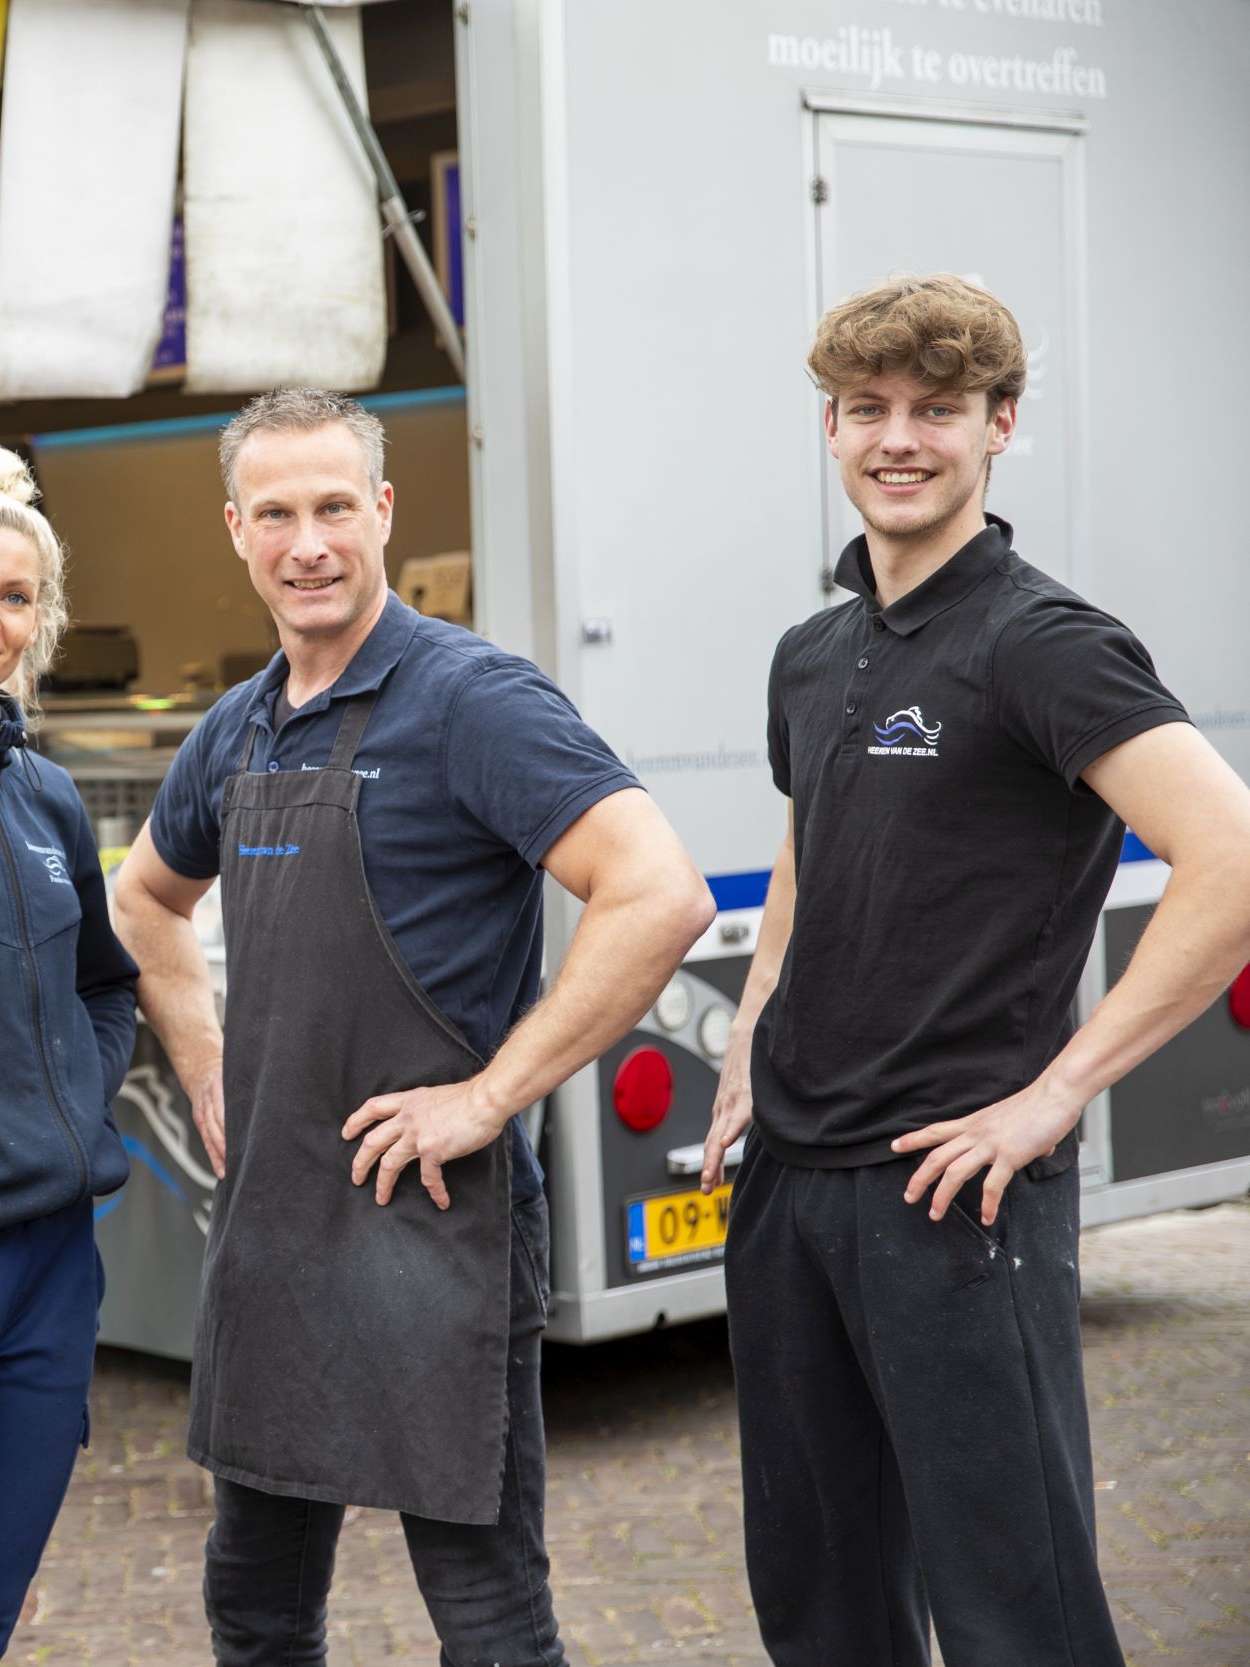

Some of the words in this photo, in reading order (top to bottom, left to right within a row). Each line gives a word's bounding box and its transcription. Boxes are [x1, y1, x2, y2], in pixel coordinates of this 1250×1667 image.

[767, 24, 904, 89] moeilijk
[912, 45, 943, 82] te
[948, 47, 1107, 98] overtreffen
[867, 746, 890, 755] HEEREN
[891, 747, 903, 756] VAN
[903, 747, 912, 756] DE
[913, 748, 939, 757] ZEE.NL
